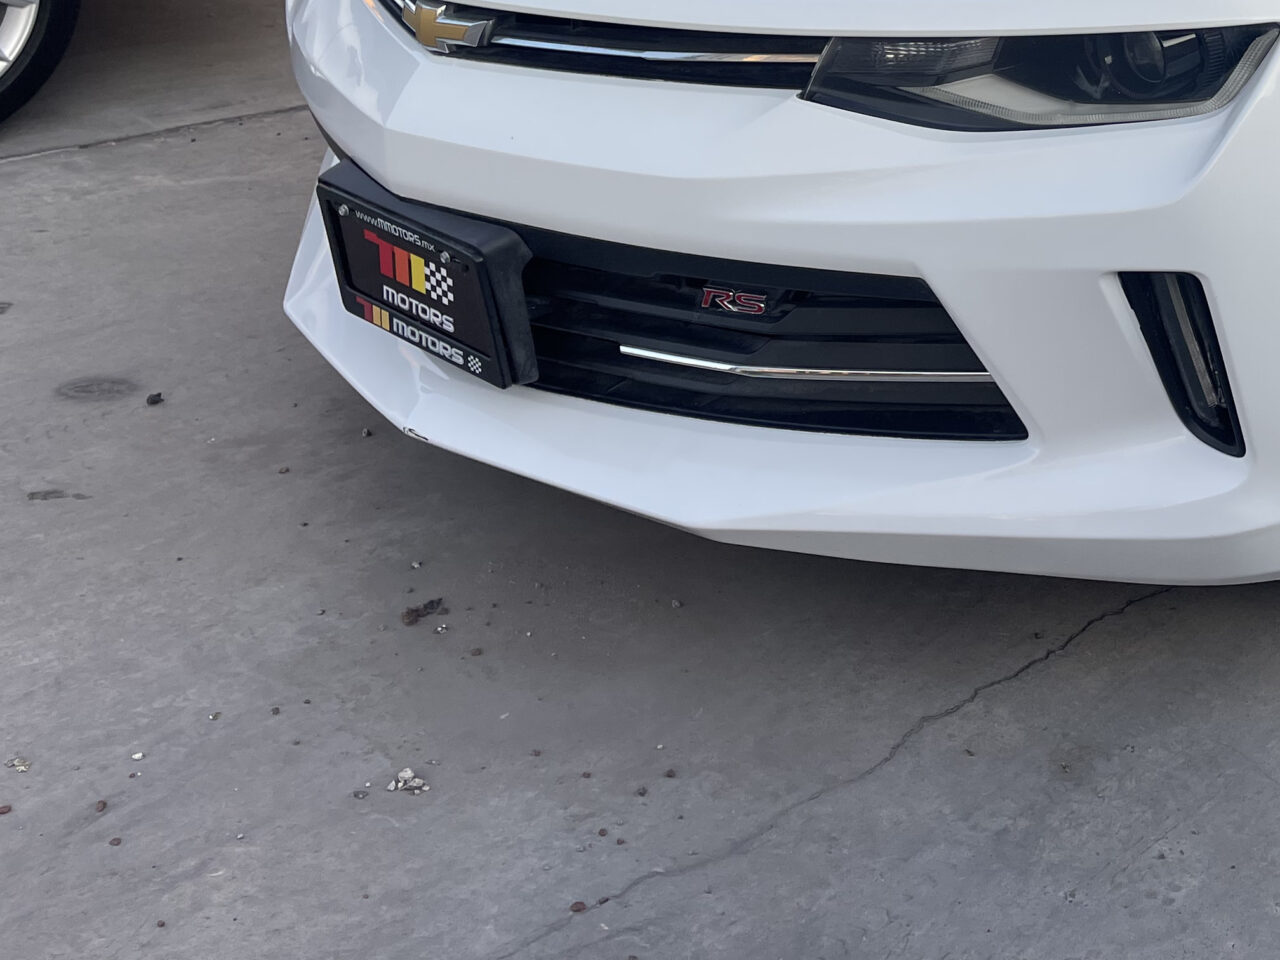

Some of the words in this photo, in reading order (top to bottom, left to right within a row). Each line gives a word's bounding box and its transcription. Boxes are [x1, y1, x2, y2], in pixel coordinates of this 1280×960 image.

[382, 283, 456, 334] MOTORS
[701, 287, 767, 315] RS
[391, 316, 465, 366] MOTORS
